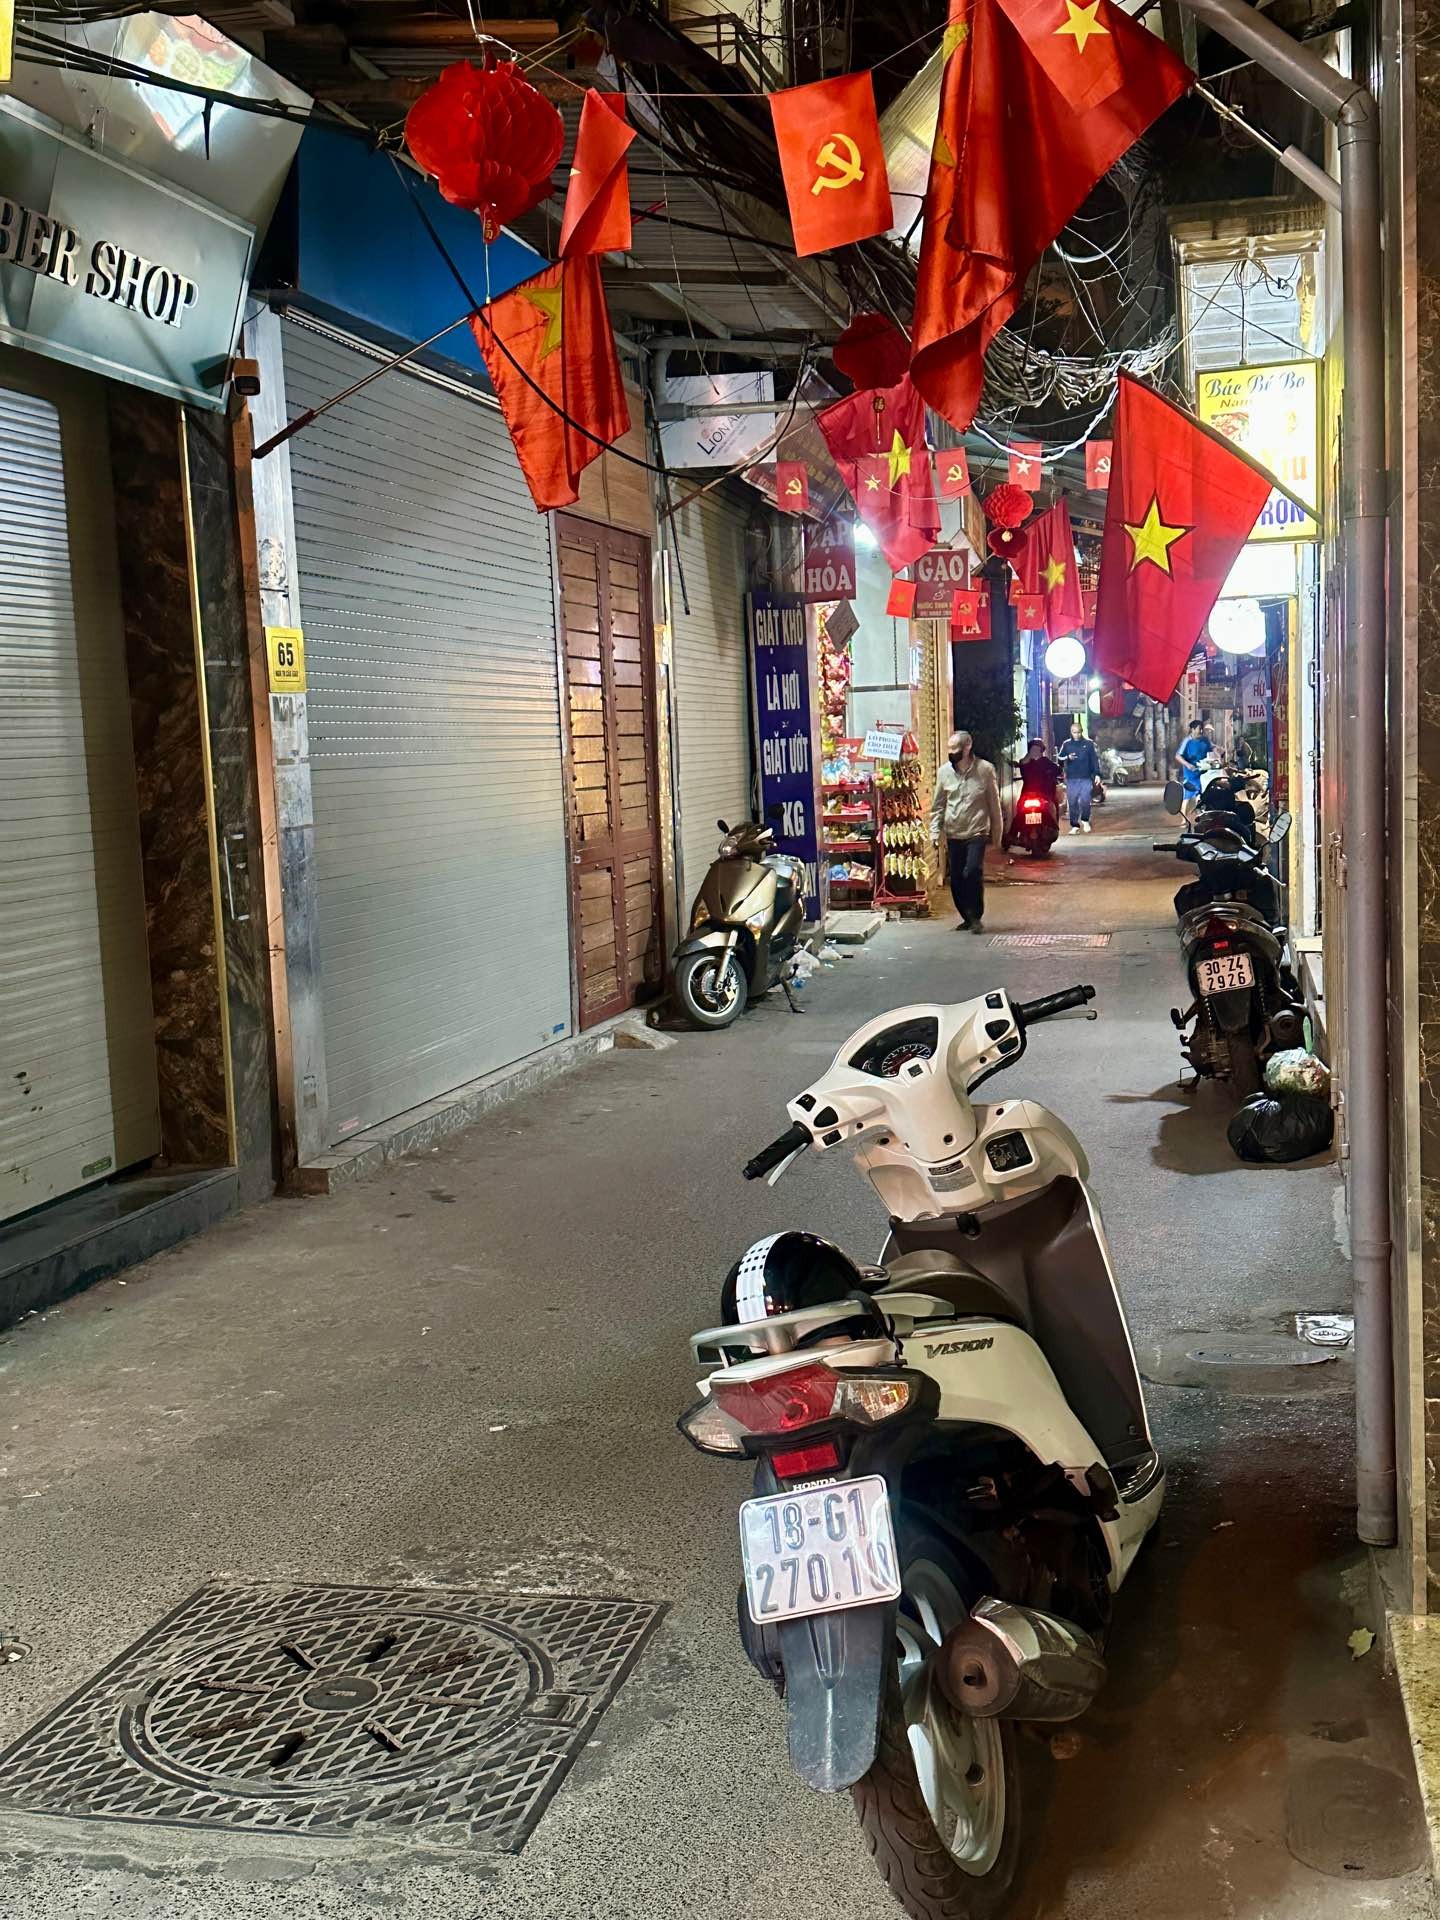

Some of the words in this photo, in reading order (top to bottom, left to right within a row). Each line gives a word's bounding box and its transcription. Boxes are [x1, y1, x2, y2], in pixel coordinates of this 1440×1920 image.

[86, 240, 199, 328] SHOP
[807, 560, 852, 593] HÓA
[918, 555, 964, 588] GẠO
[755, 601, 779, 654] GIẶT
[781, 601, 804, 646] KHÔ
[278, 642, 294, 667] 65
[766, 666, 780, 710] LÀ
[781, 670, 800, 710] HƠI
[763, 731, 787, 783] GIẶT
[788, 729, 809, 773] ƯỚT
[782, 800, 805, 837] KG
[1205, 957, 1243, 976] 30-Z4
[1207, 972, 1246, 991] 2926
[923, 1337, 994, 1359] VISION
[793, 1477, 837, 1491] HONDA
